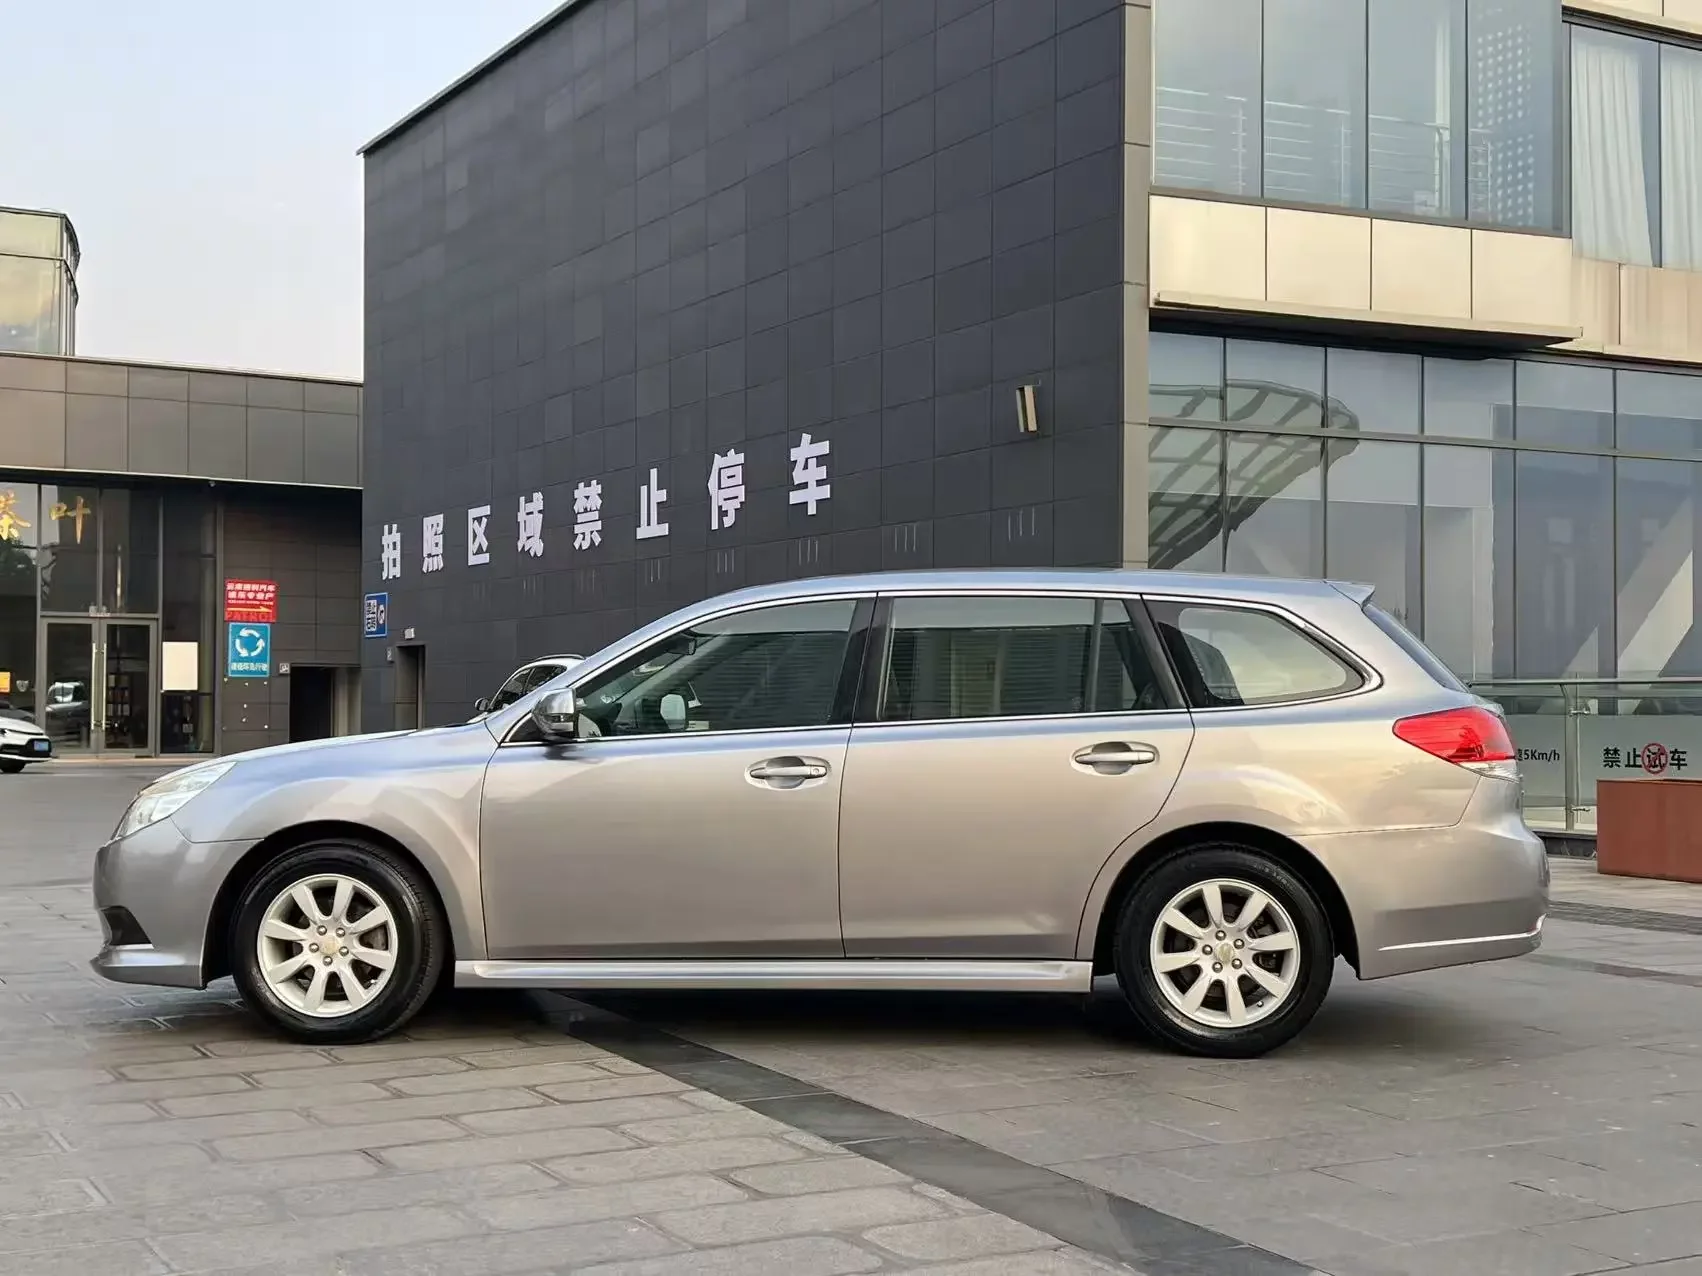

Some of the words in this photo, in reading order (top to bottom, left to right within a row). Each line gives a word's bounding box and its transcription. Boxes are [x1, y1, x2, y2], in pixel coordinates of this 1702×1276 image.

[381, 433, 831, 580] 拍照区域禁止停车
[1603, 746, 1688, 771] 禁止试车
